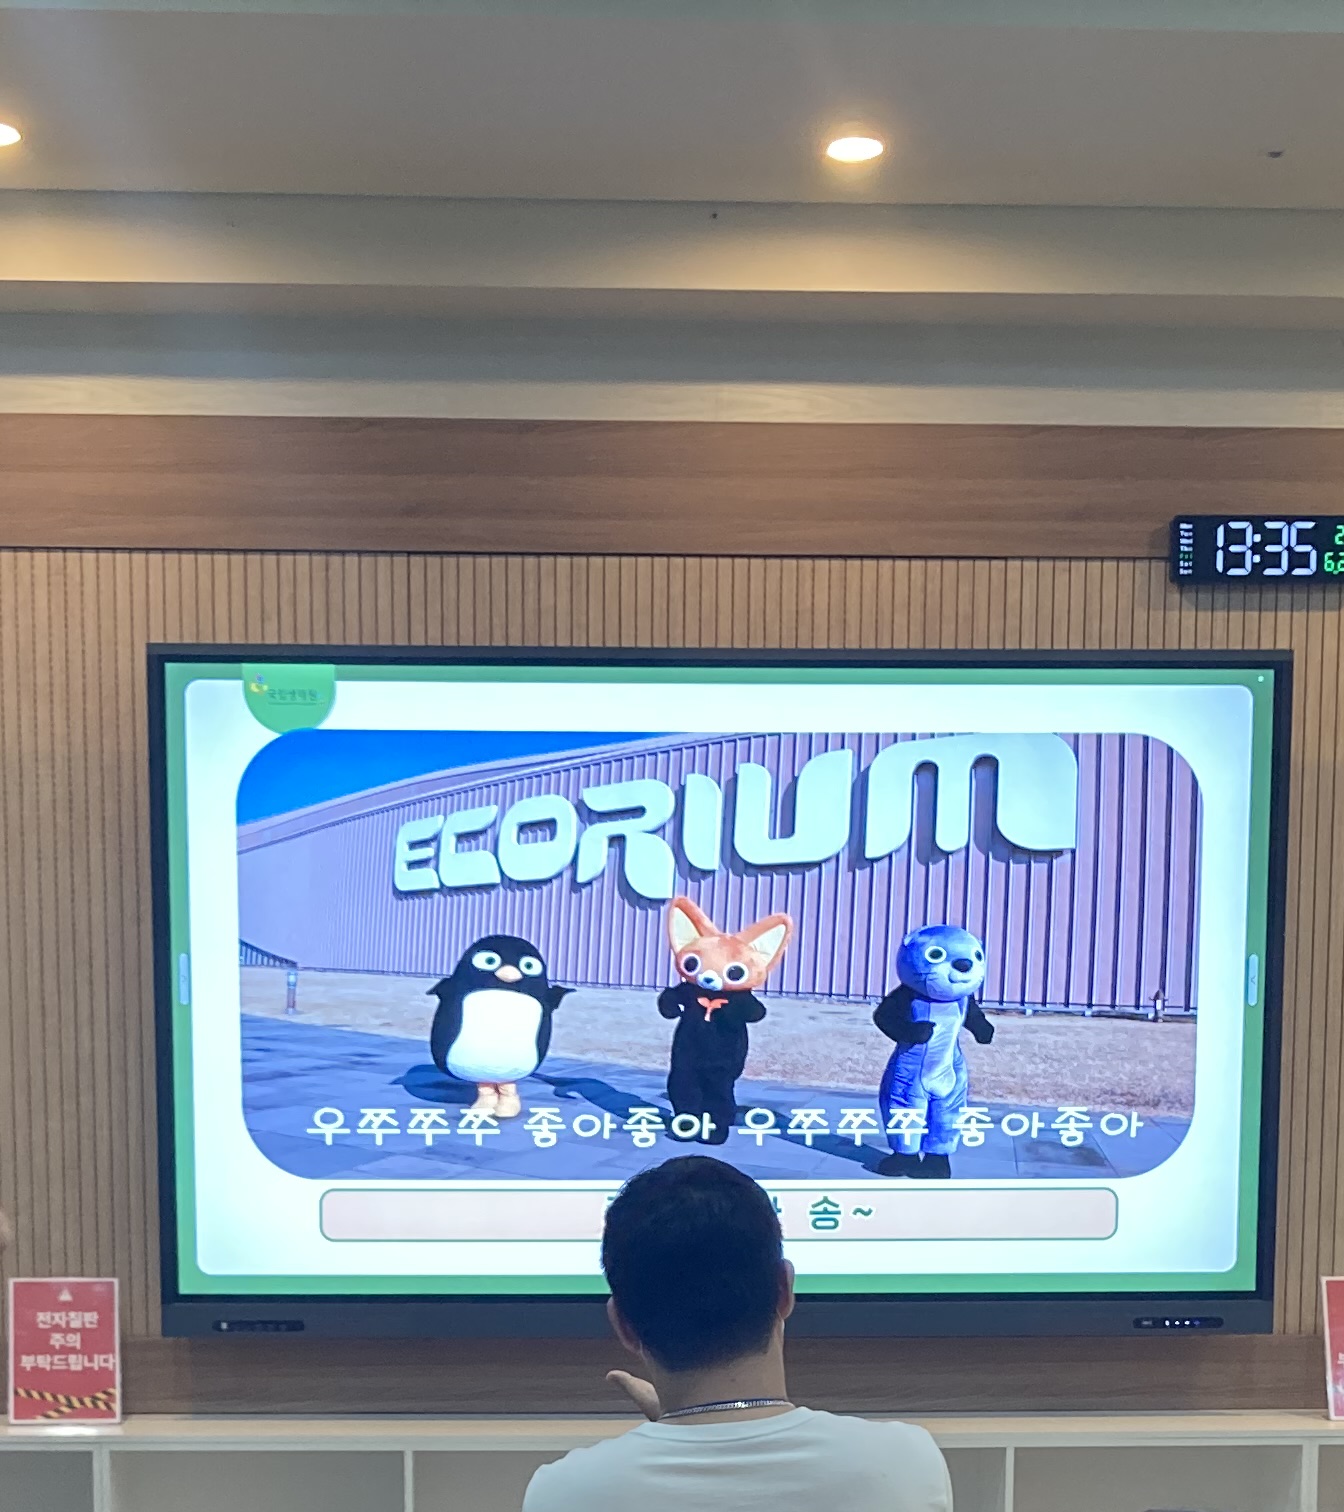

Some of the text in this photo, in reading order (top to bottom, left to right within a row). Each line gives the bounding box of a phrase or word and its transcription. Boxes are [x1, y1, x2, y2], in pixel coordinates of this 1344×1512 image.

[1215, 521, 1318, 576] 13:35
[393, 733, 1078, 901] ECORIUM
[306, 1105, 1144, 1148] 우쭈쭈쭈 좋아좋아 우쭈쭈쭈 좋아좋아
[36, 1311, 99, 1329] 전자칠판
[49, 1332, 81, 1350] 주의
